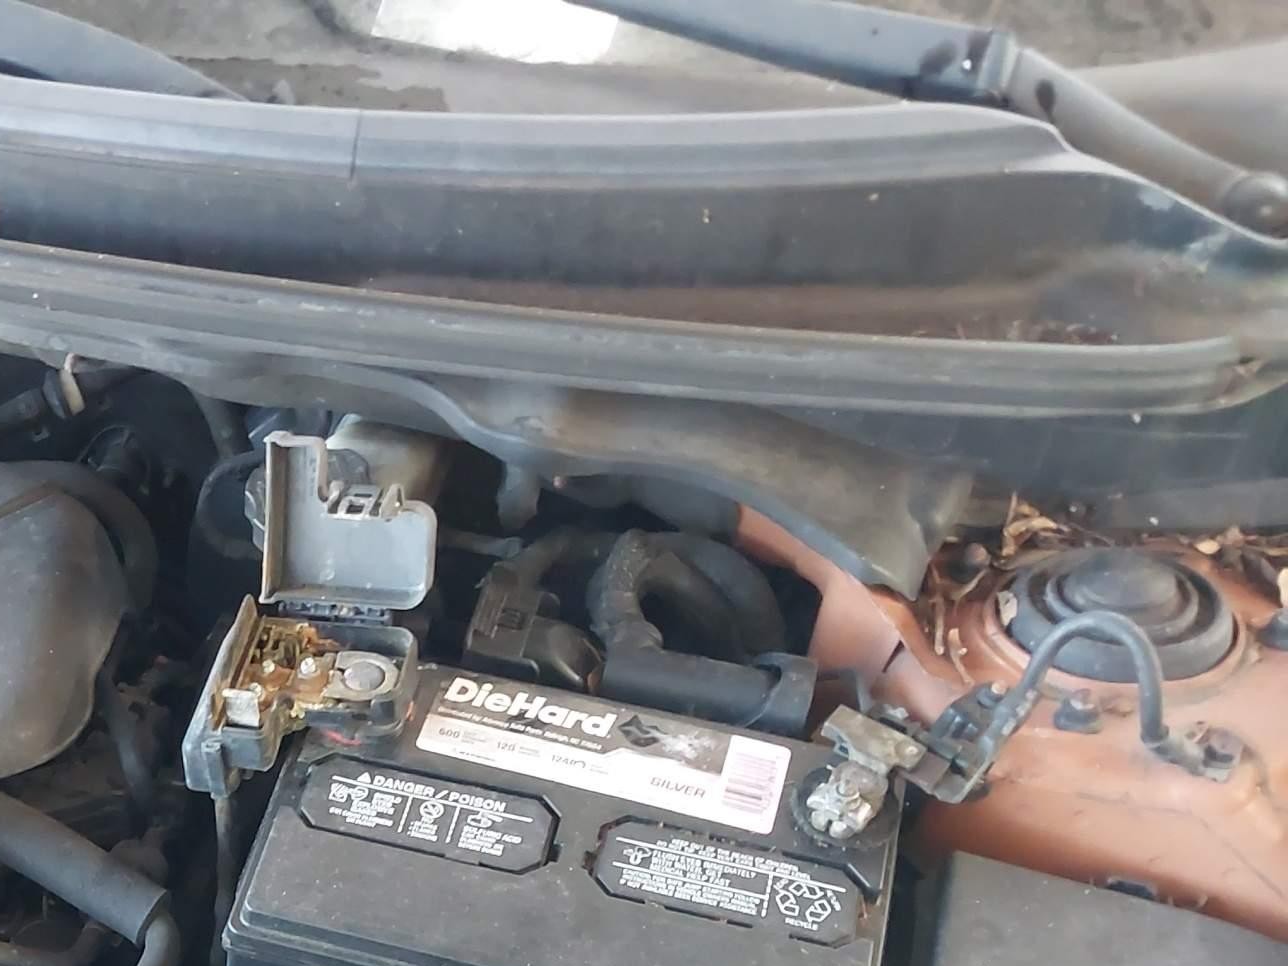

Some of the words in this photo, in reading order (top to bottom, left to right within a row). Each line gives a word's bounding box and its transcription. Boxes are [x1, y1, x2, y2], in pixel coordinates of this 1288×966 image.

[444, 677, 617, 738] DieHard
[438, 726, 460, 739] 600
[373, 775, 435, 798] DANGER
[449, 791, 507, 813] POISON
[650, 776, 707, 800] SILVER
